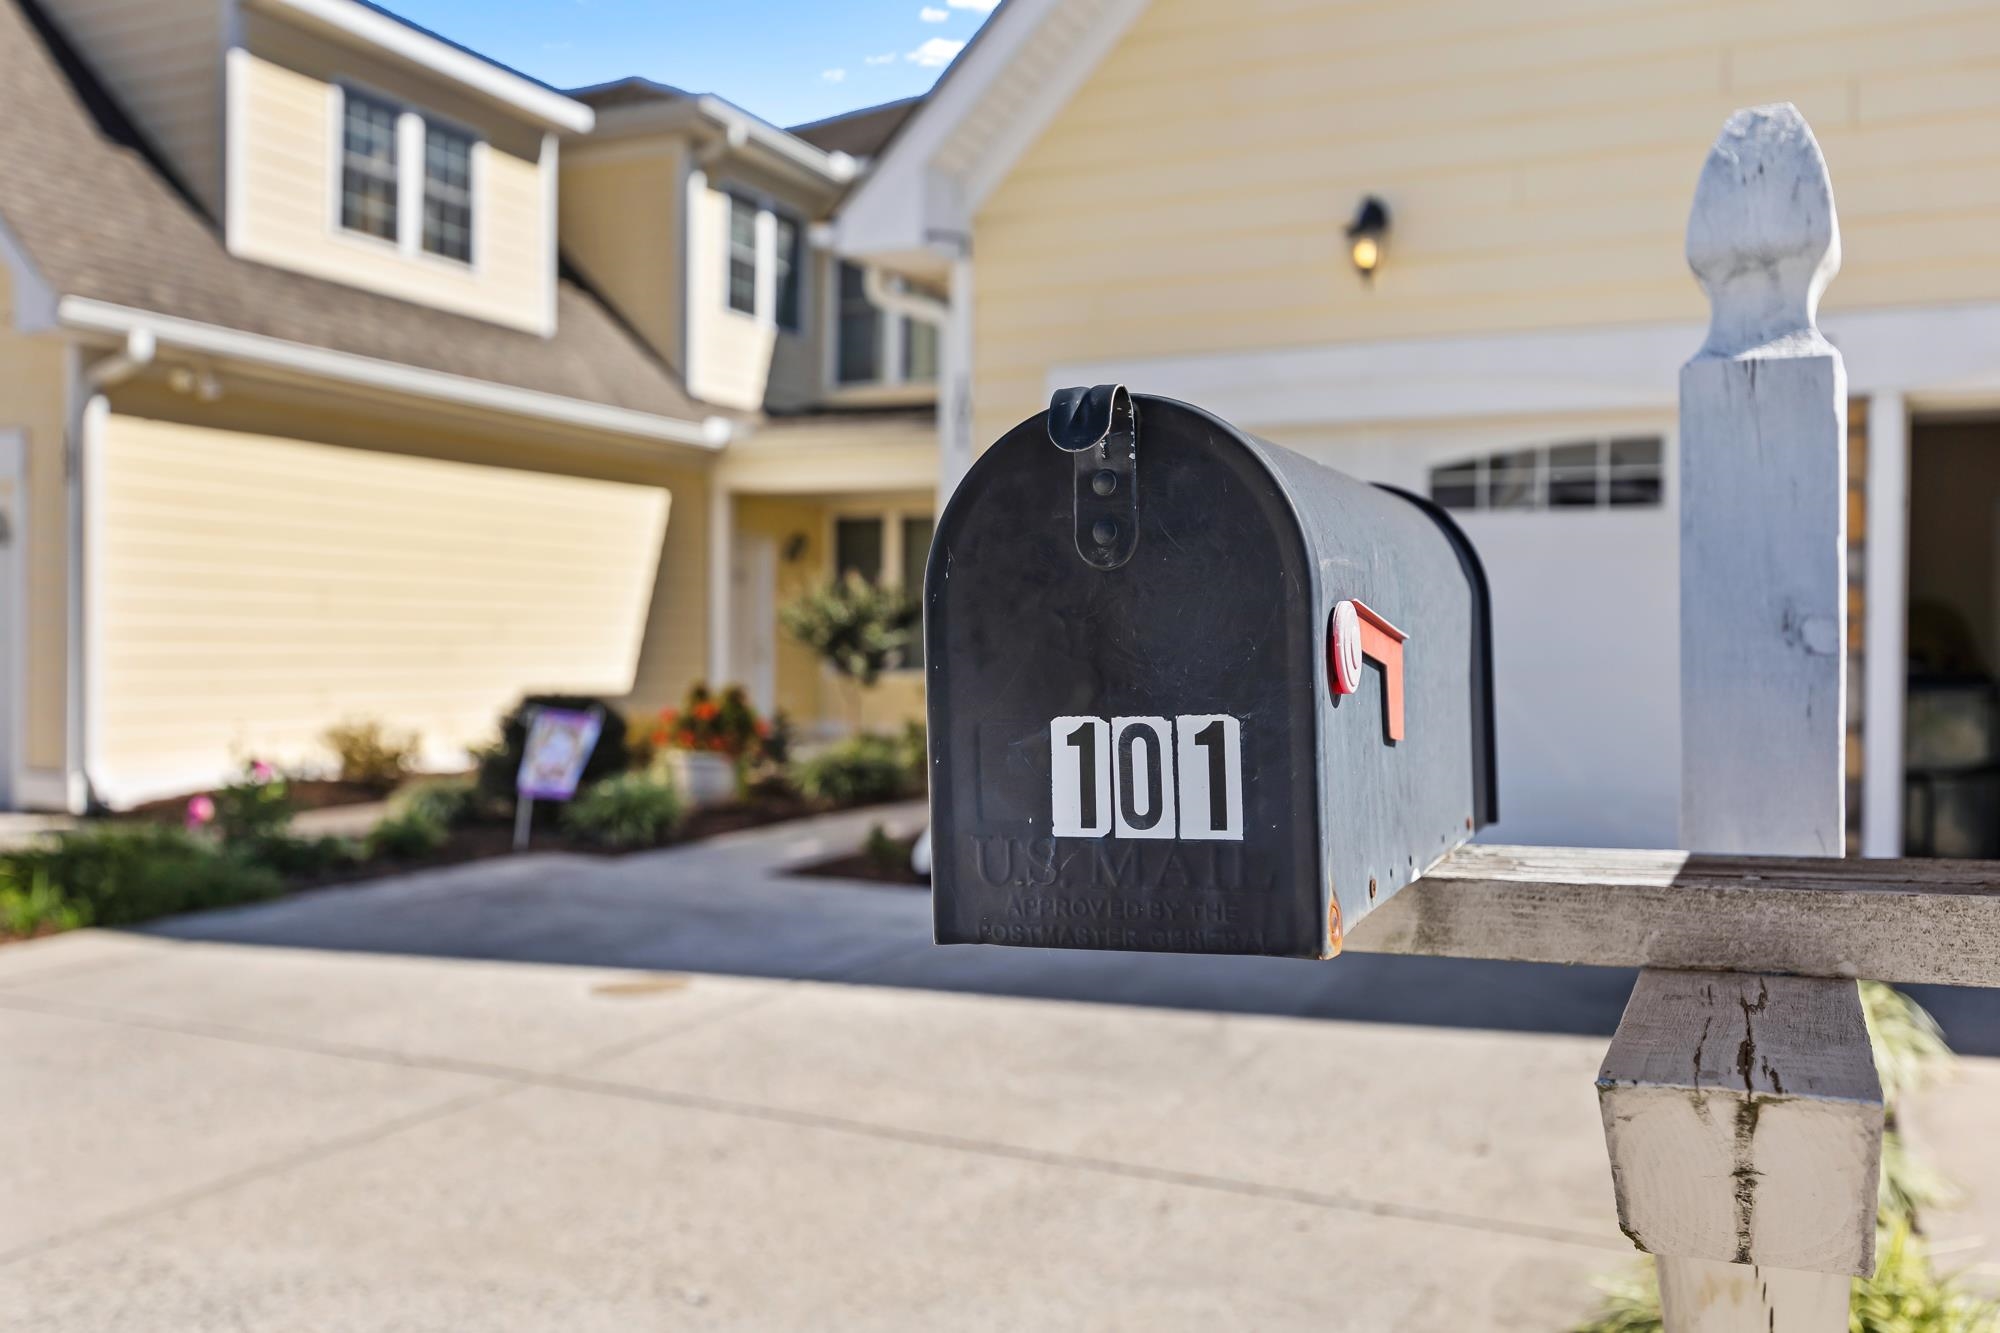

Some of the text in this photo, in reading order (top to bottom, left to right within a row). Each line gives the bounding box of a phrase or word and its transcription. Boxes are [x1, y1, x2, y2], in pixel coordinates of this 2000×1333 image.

[1066, 720, 1228, 831] 101
[1085, 839, 1277, 895] MAIL
[1006, 896, 1240, 925] APPROVED BY THE
[976, 920, 1138, 947] POSTMASTER
